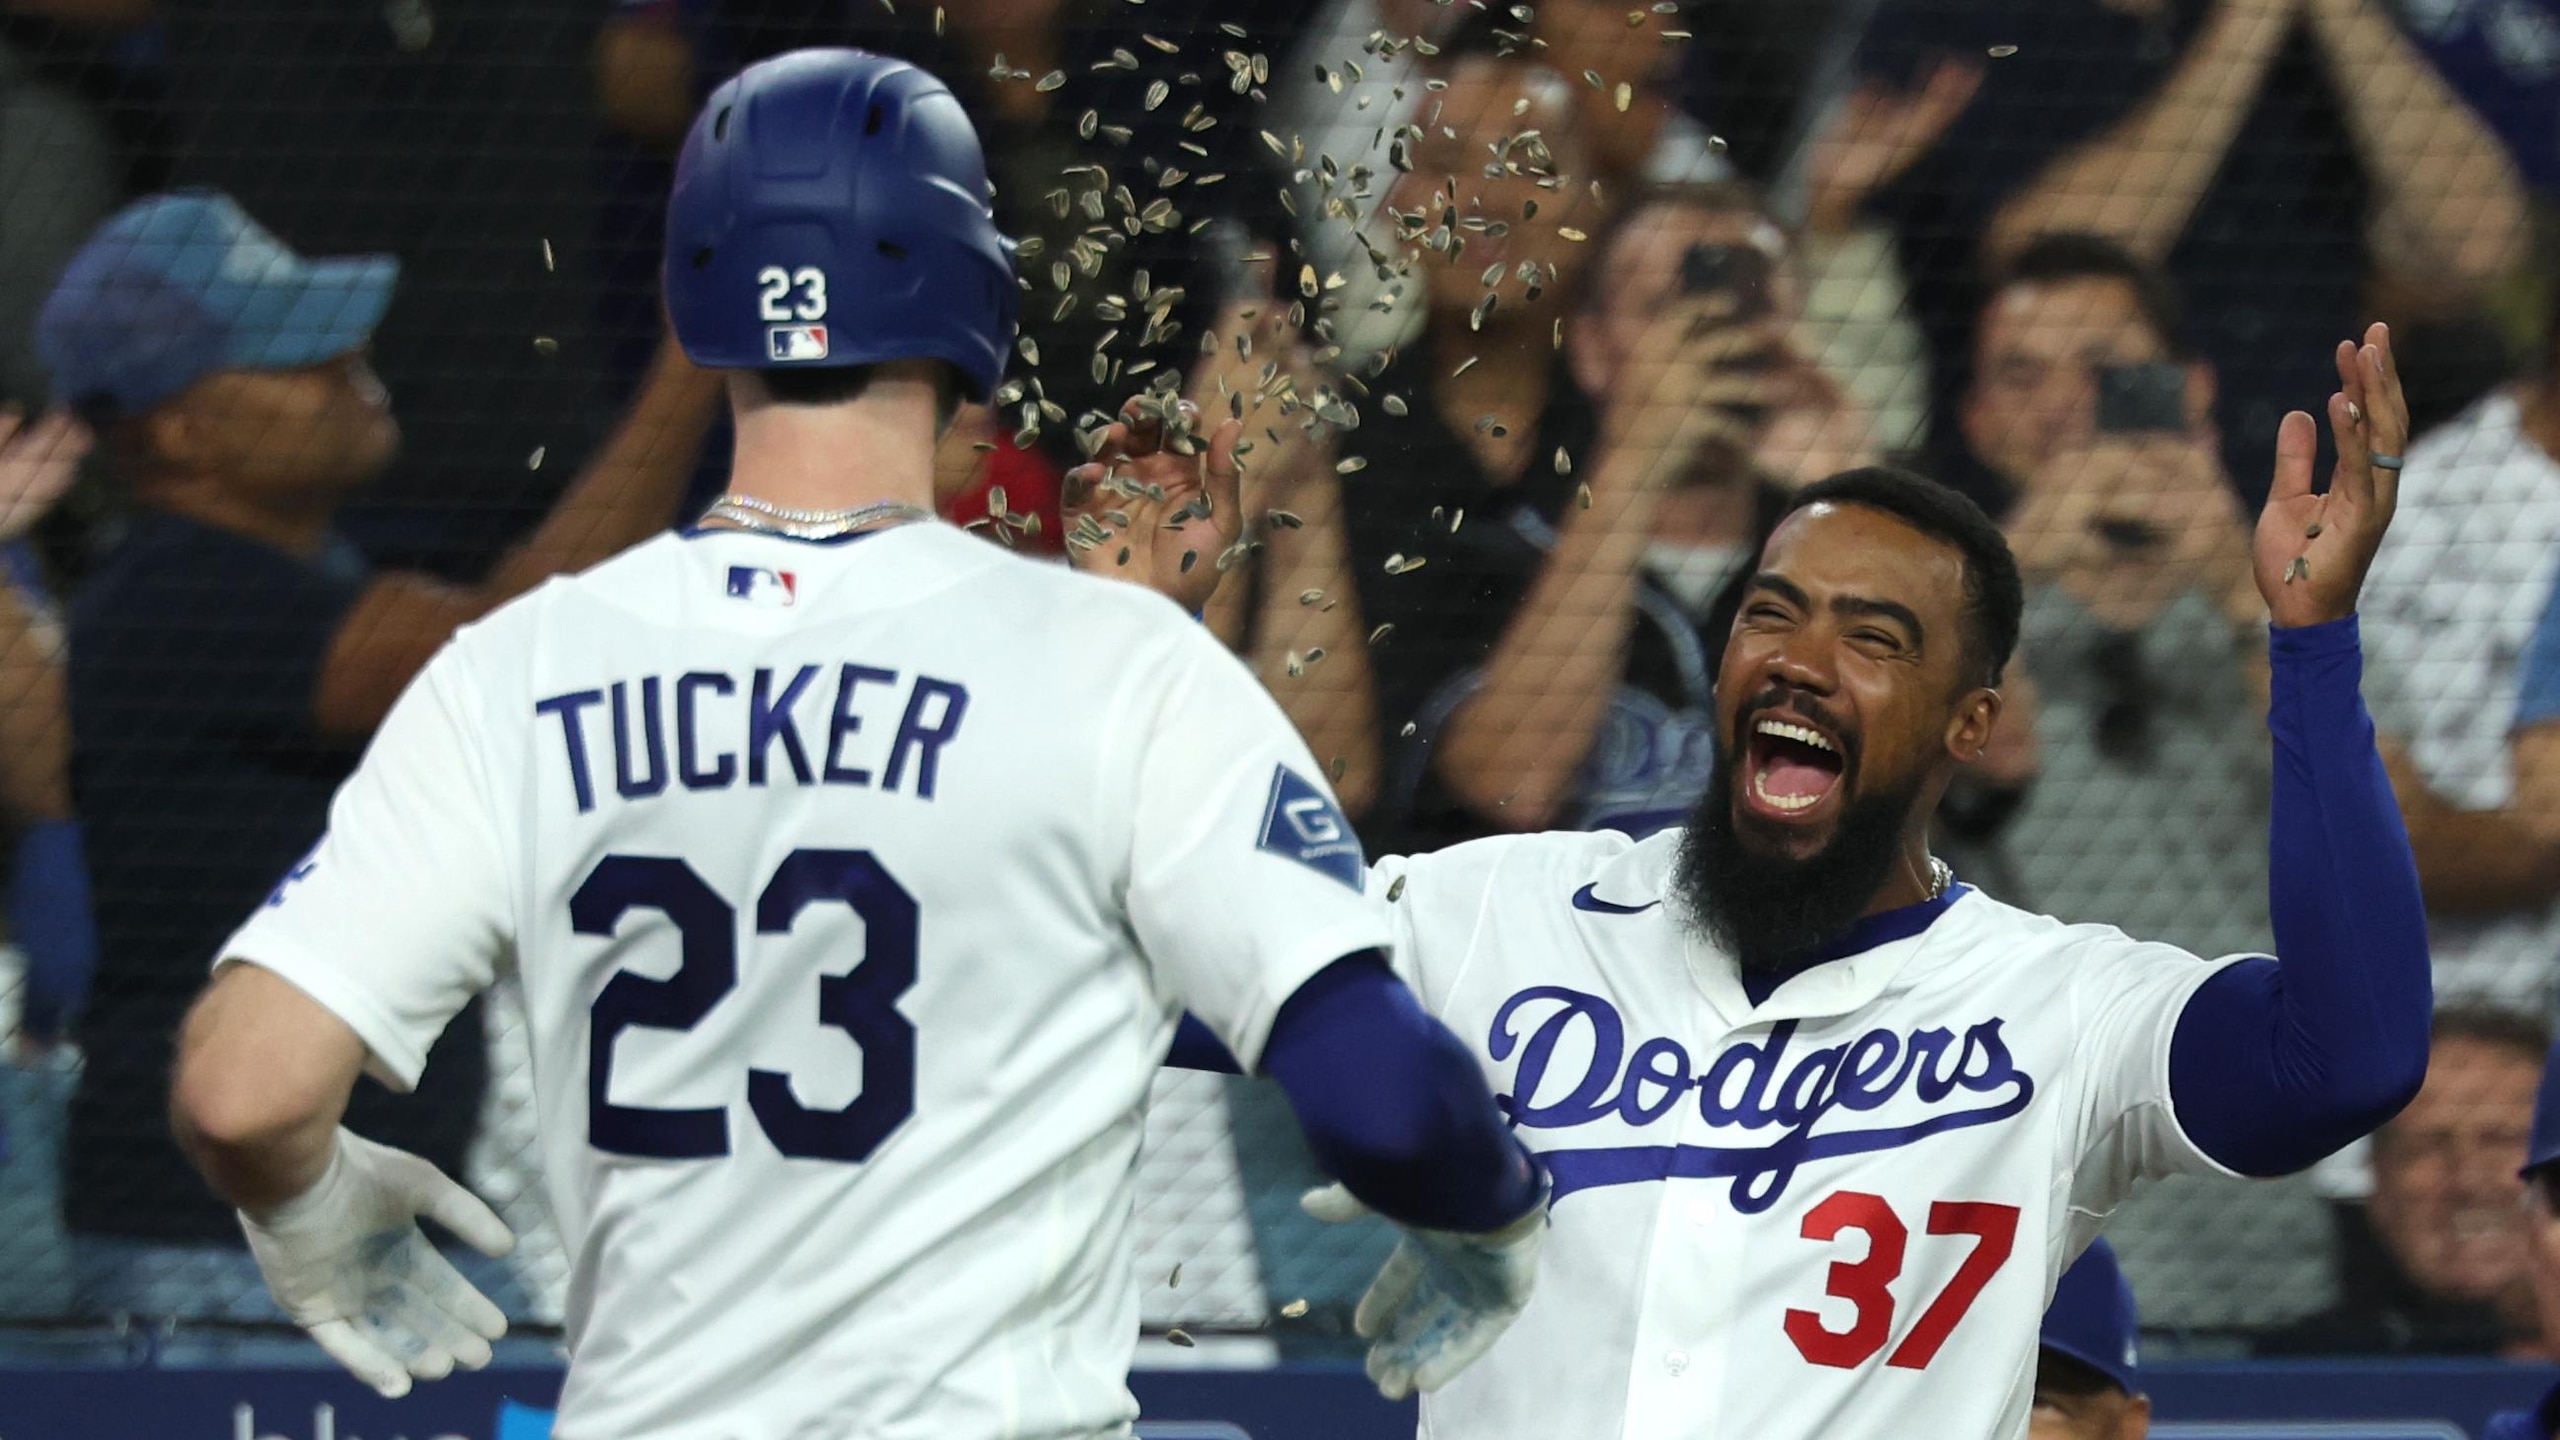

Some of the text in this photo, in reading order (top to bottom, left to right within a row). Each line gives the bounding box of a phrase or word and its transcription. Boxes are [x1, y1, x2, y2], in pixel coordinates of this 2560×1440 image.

[759, 265, 828, 321] 23
[536, 663, 970, 813] TUCKER
[1285, 797, 1341, 842] G
[569, 849, 921, 1163] 23
[1489, 986, 2034, 1214] Dodgers
[1784, 1190, 2021, 1370] 37
